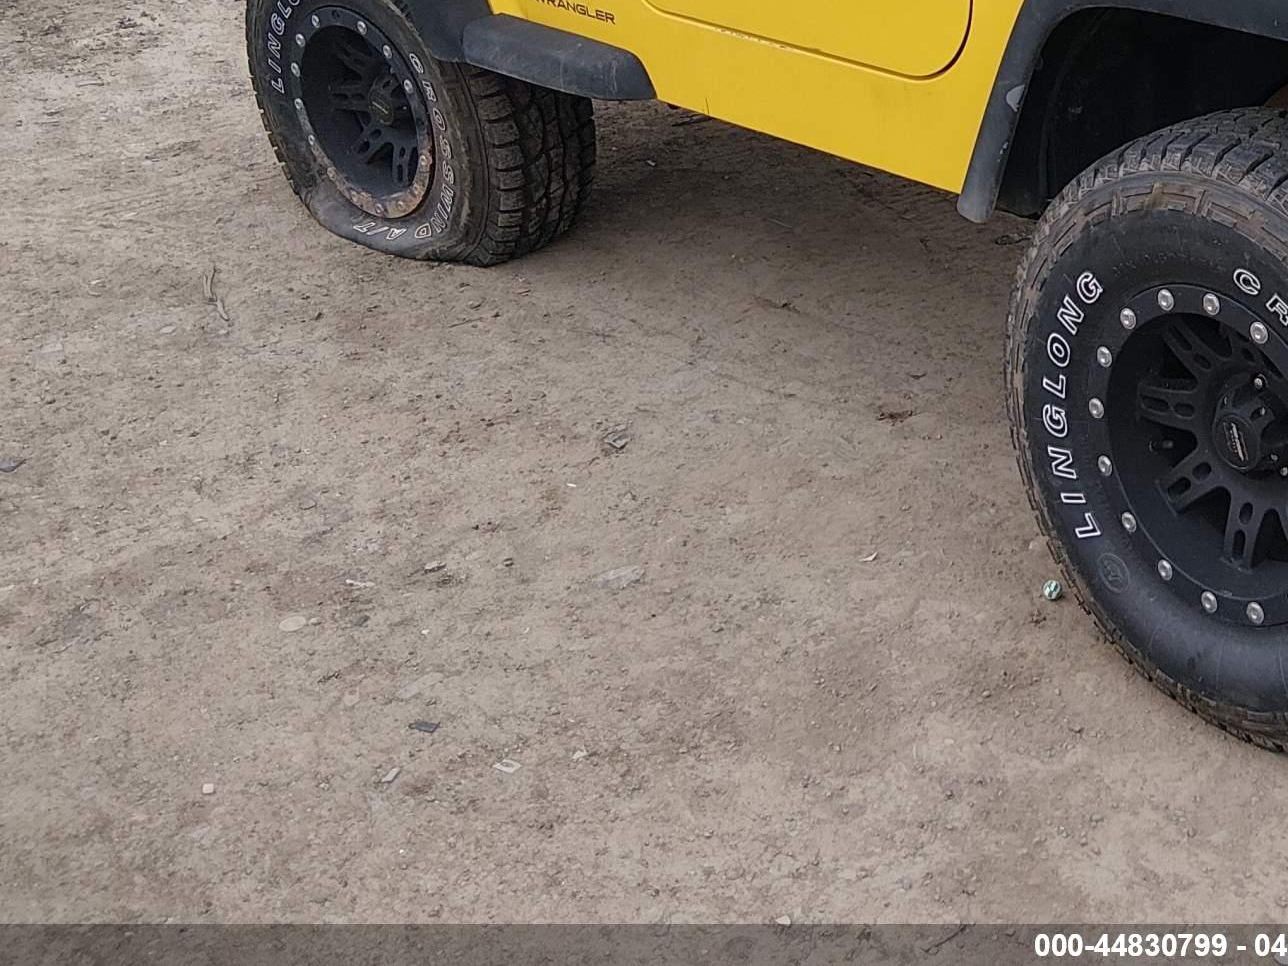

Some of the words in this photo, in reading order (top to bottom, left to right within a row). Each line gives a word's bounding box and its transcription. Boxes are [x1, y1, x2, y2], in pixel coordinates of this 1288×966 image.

[352, 219, 408, 241] A/T
[407, 52, 455, 240] CROSSWIND
[1042, 271, 1104, 541] LINGLONG
